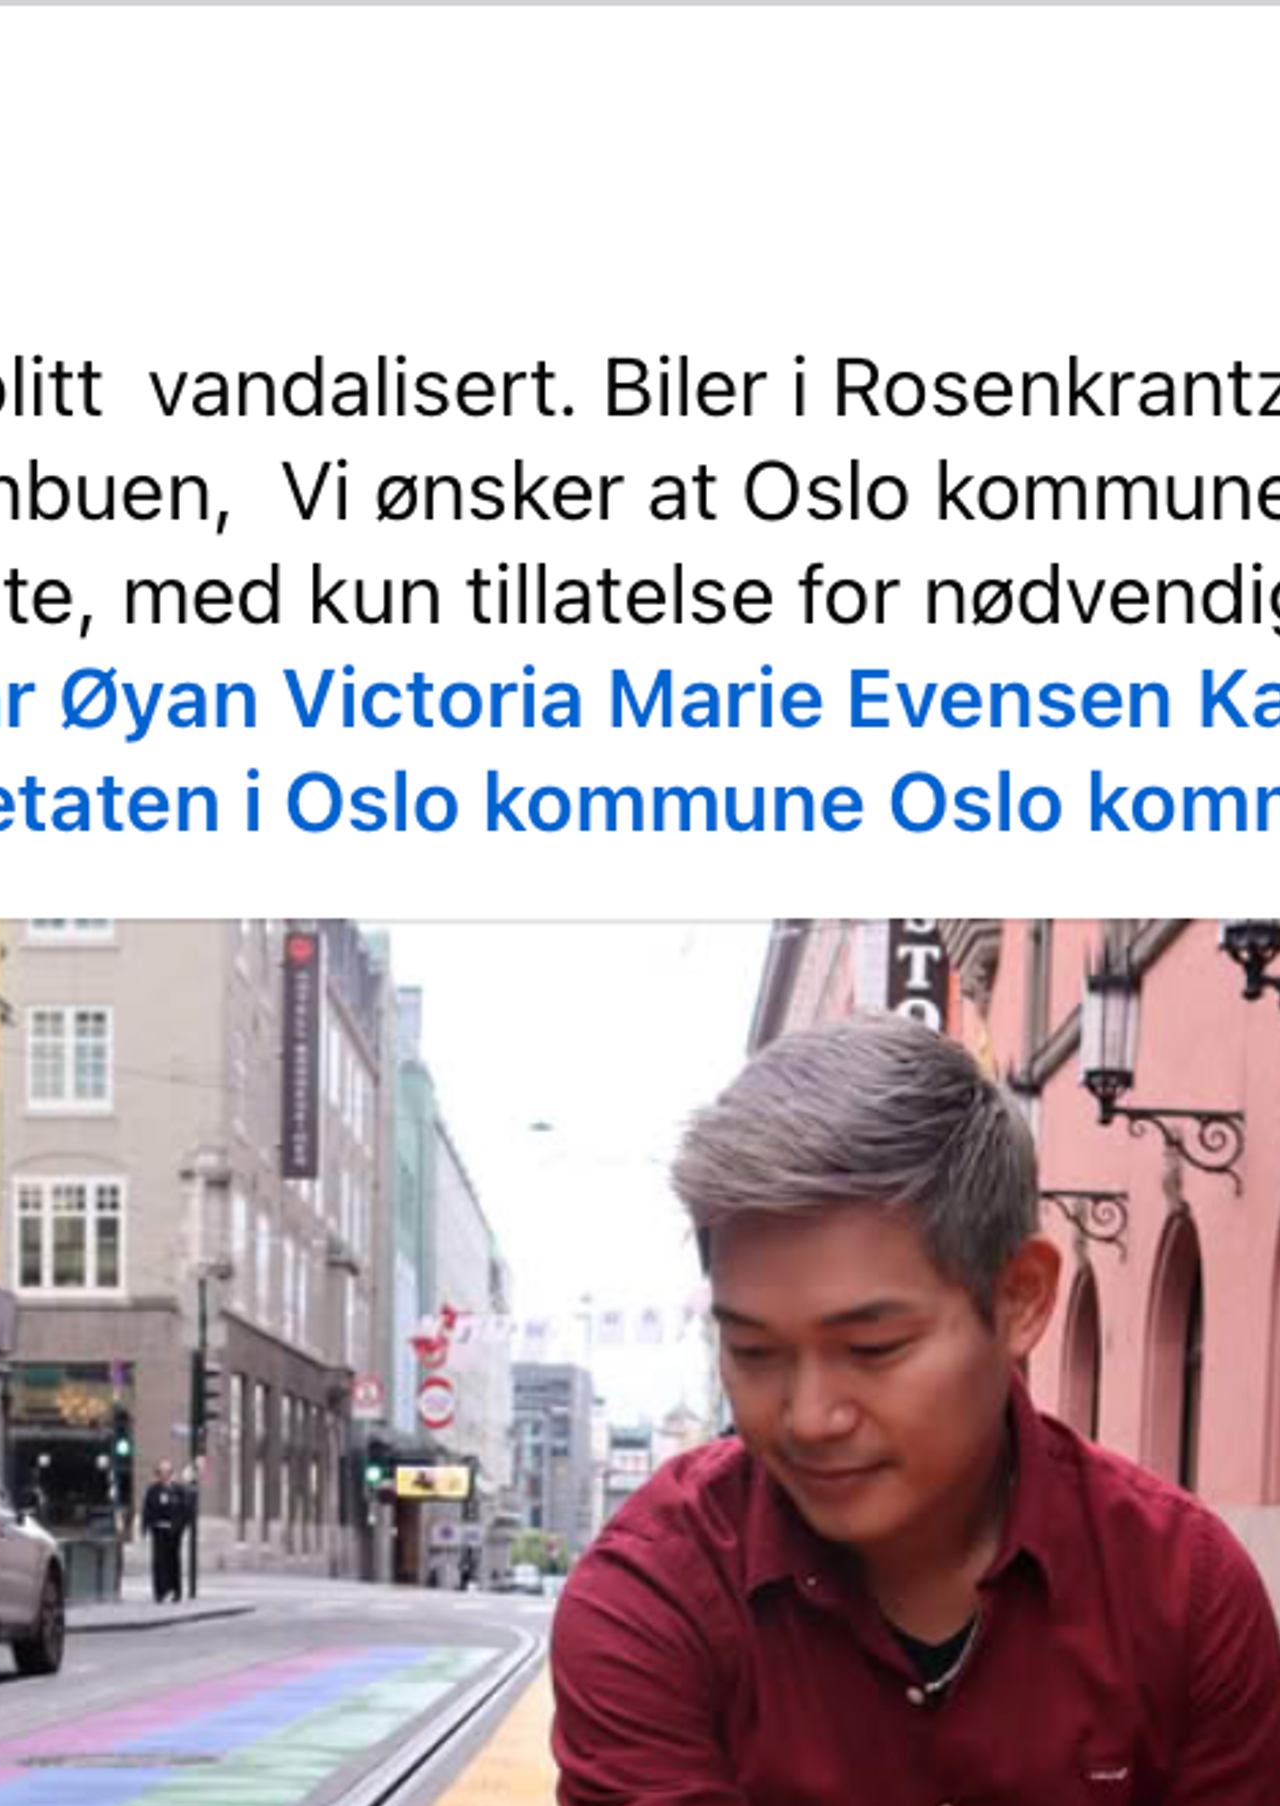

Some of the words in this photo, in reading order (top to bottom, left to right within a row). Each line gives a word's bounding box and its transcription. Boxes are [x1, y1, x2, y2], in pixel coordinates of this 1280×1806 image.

[148, 353, 575, 418] vandalisert.
[606, 353, 768, 418] Biler
[793, 353, 806, 417] i
[280, 457, 349, 521] Vi
[375, 458, 626, 523] ønsker
[648, 463, 718, 522] at
[743, 458, 910, 523] Oslo
[125, 561, 281, 626] med
[311, 561, 440, 626] kun
[465, 561, 773, 626] tillatelse
[797, 561, 901, 626] for
[60, 666, 257, 745] Øyan
[282, 663, 582, 730] Victoria
[610, 663, 824, 729] Marie
[850, 668, 1171, 730] Evensen
[246, 767, 260, 832] i
[286, 769, 459, 834] Oslo
[486, 769, 865, 833] kommune
[890, 769, 1063, 834] Oslo
